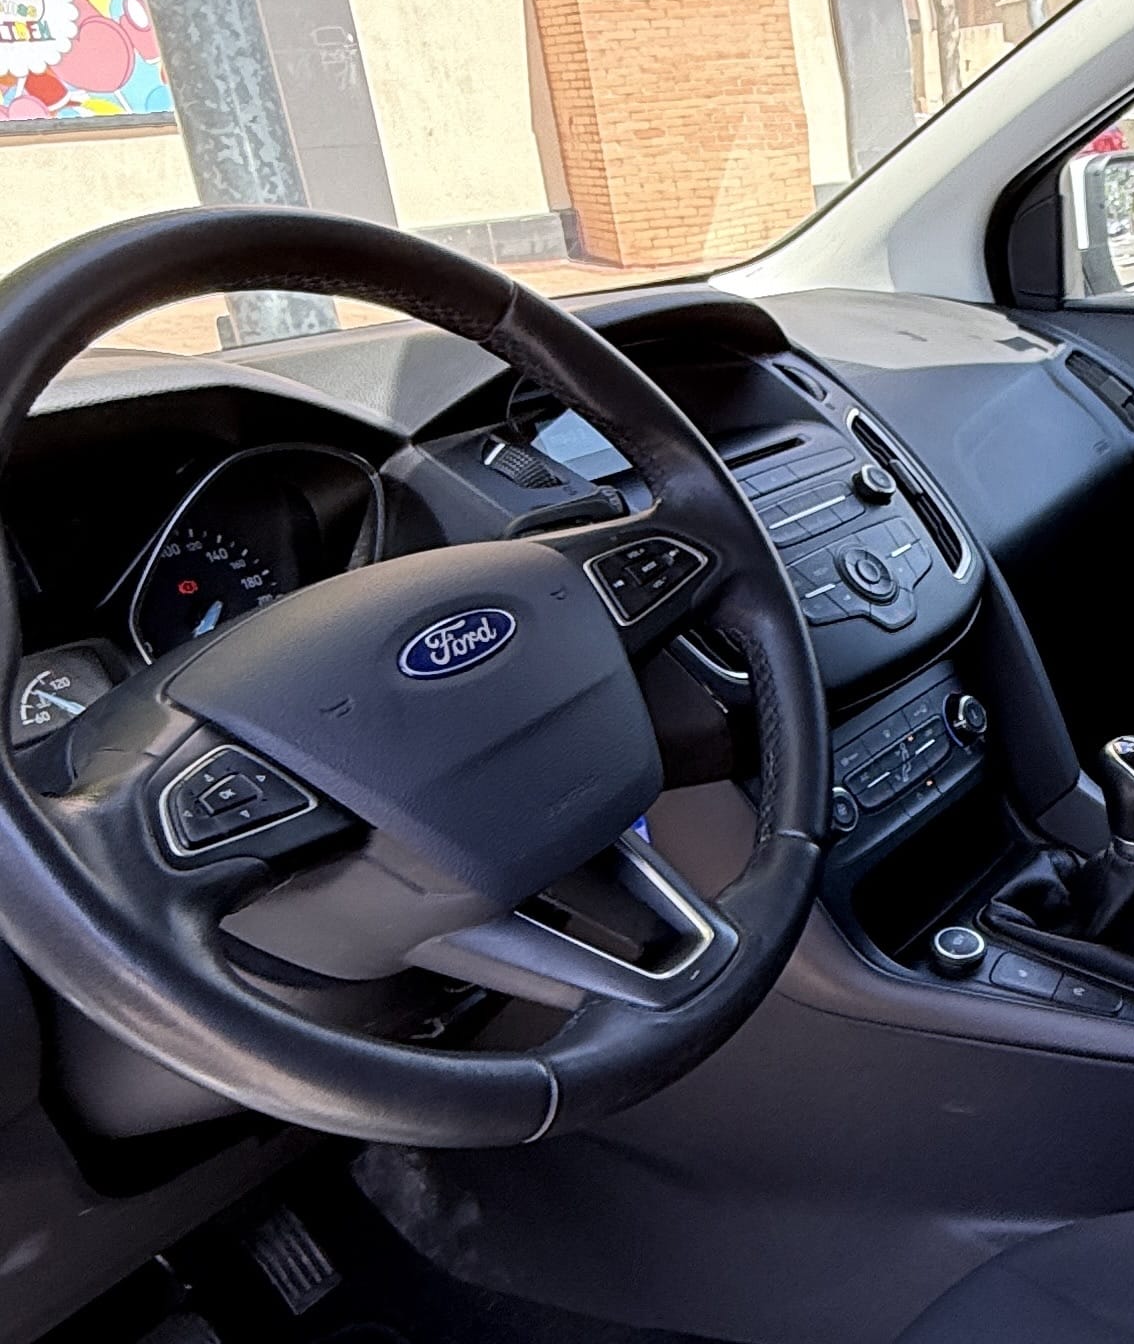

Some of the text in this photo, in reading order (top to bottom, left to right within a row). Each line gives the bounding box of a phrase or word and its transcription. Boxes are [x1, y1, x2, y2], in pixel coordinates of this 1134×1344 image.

[205, 547, 229, 562] 140
[240, 574, 263, 590] 180
[424, 616, 498, 666] Ford
[49, 676, 71, 691] 120
[35, 710, 51, 724] 60
